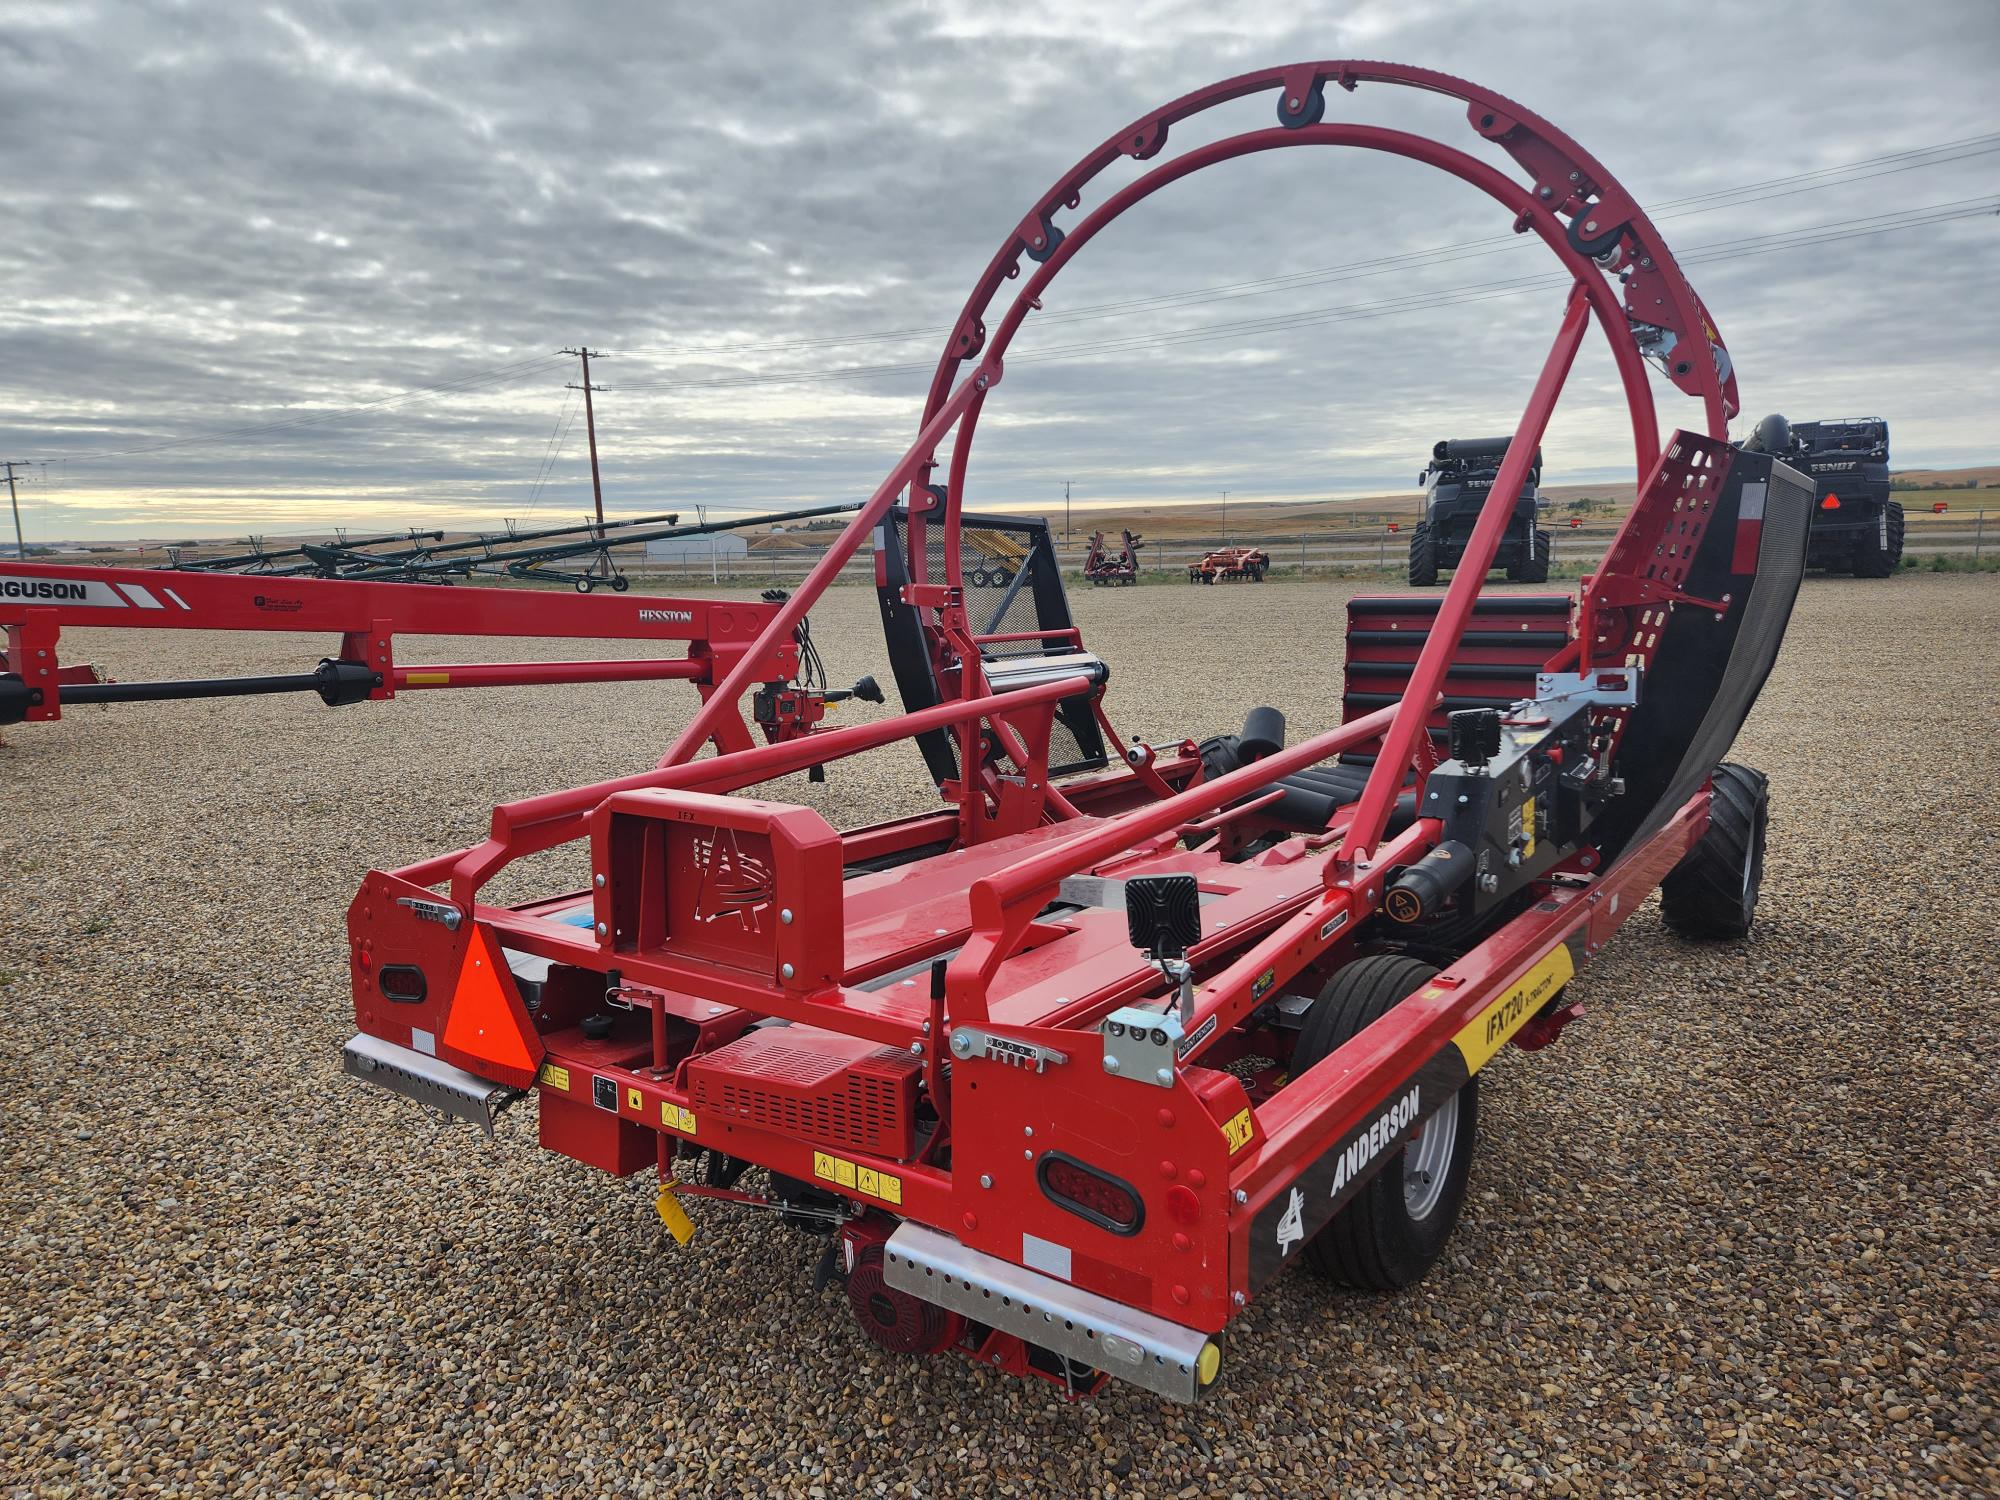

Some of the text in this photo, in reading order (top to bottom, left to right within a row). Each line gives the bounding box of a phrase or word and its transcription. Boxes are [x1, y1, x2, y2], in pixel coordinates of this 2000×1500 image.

[1811, 461, 1857, 472] FENDT
[0, 581, 87, 600] GUSON
[639, 609, 692, 622] HESSTON
[678, 811, 695, 821] IFX
[1486, 990, 1523, 1045] IFX720
[1331, 1085, 1420, 1198] ANDERSON
